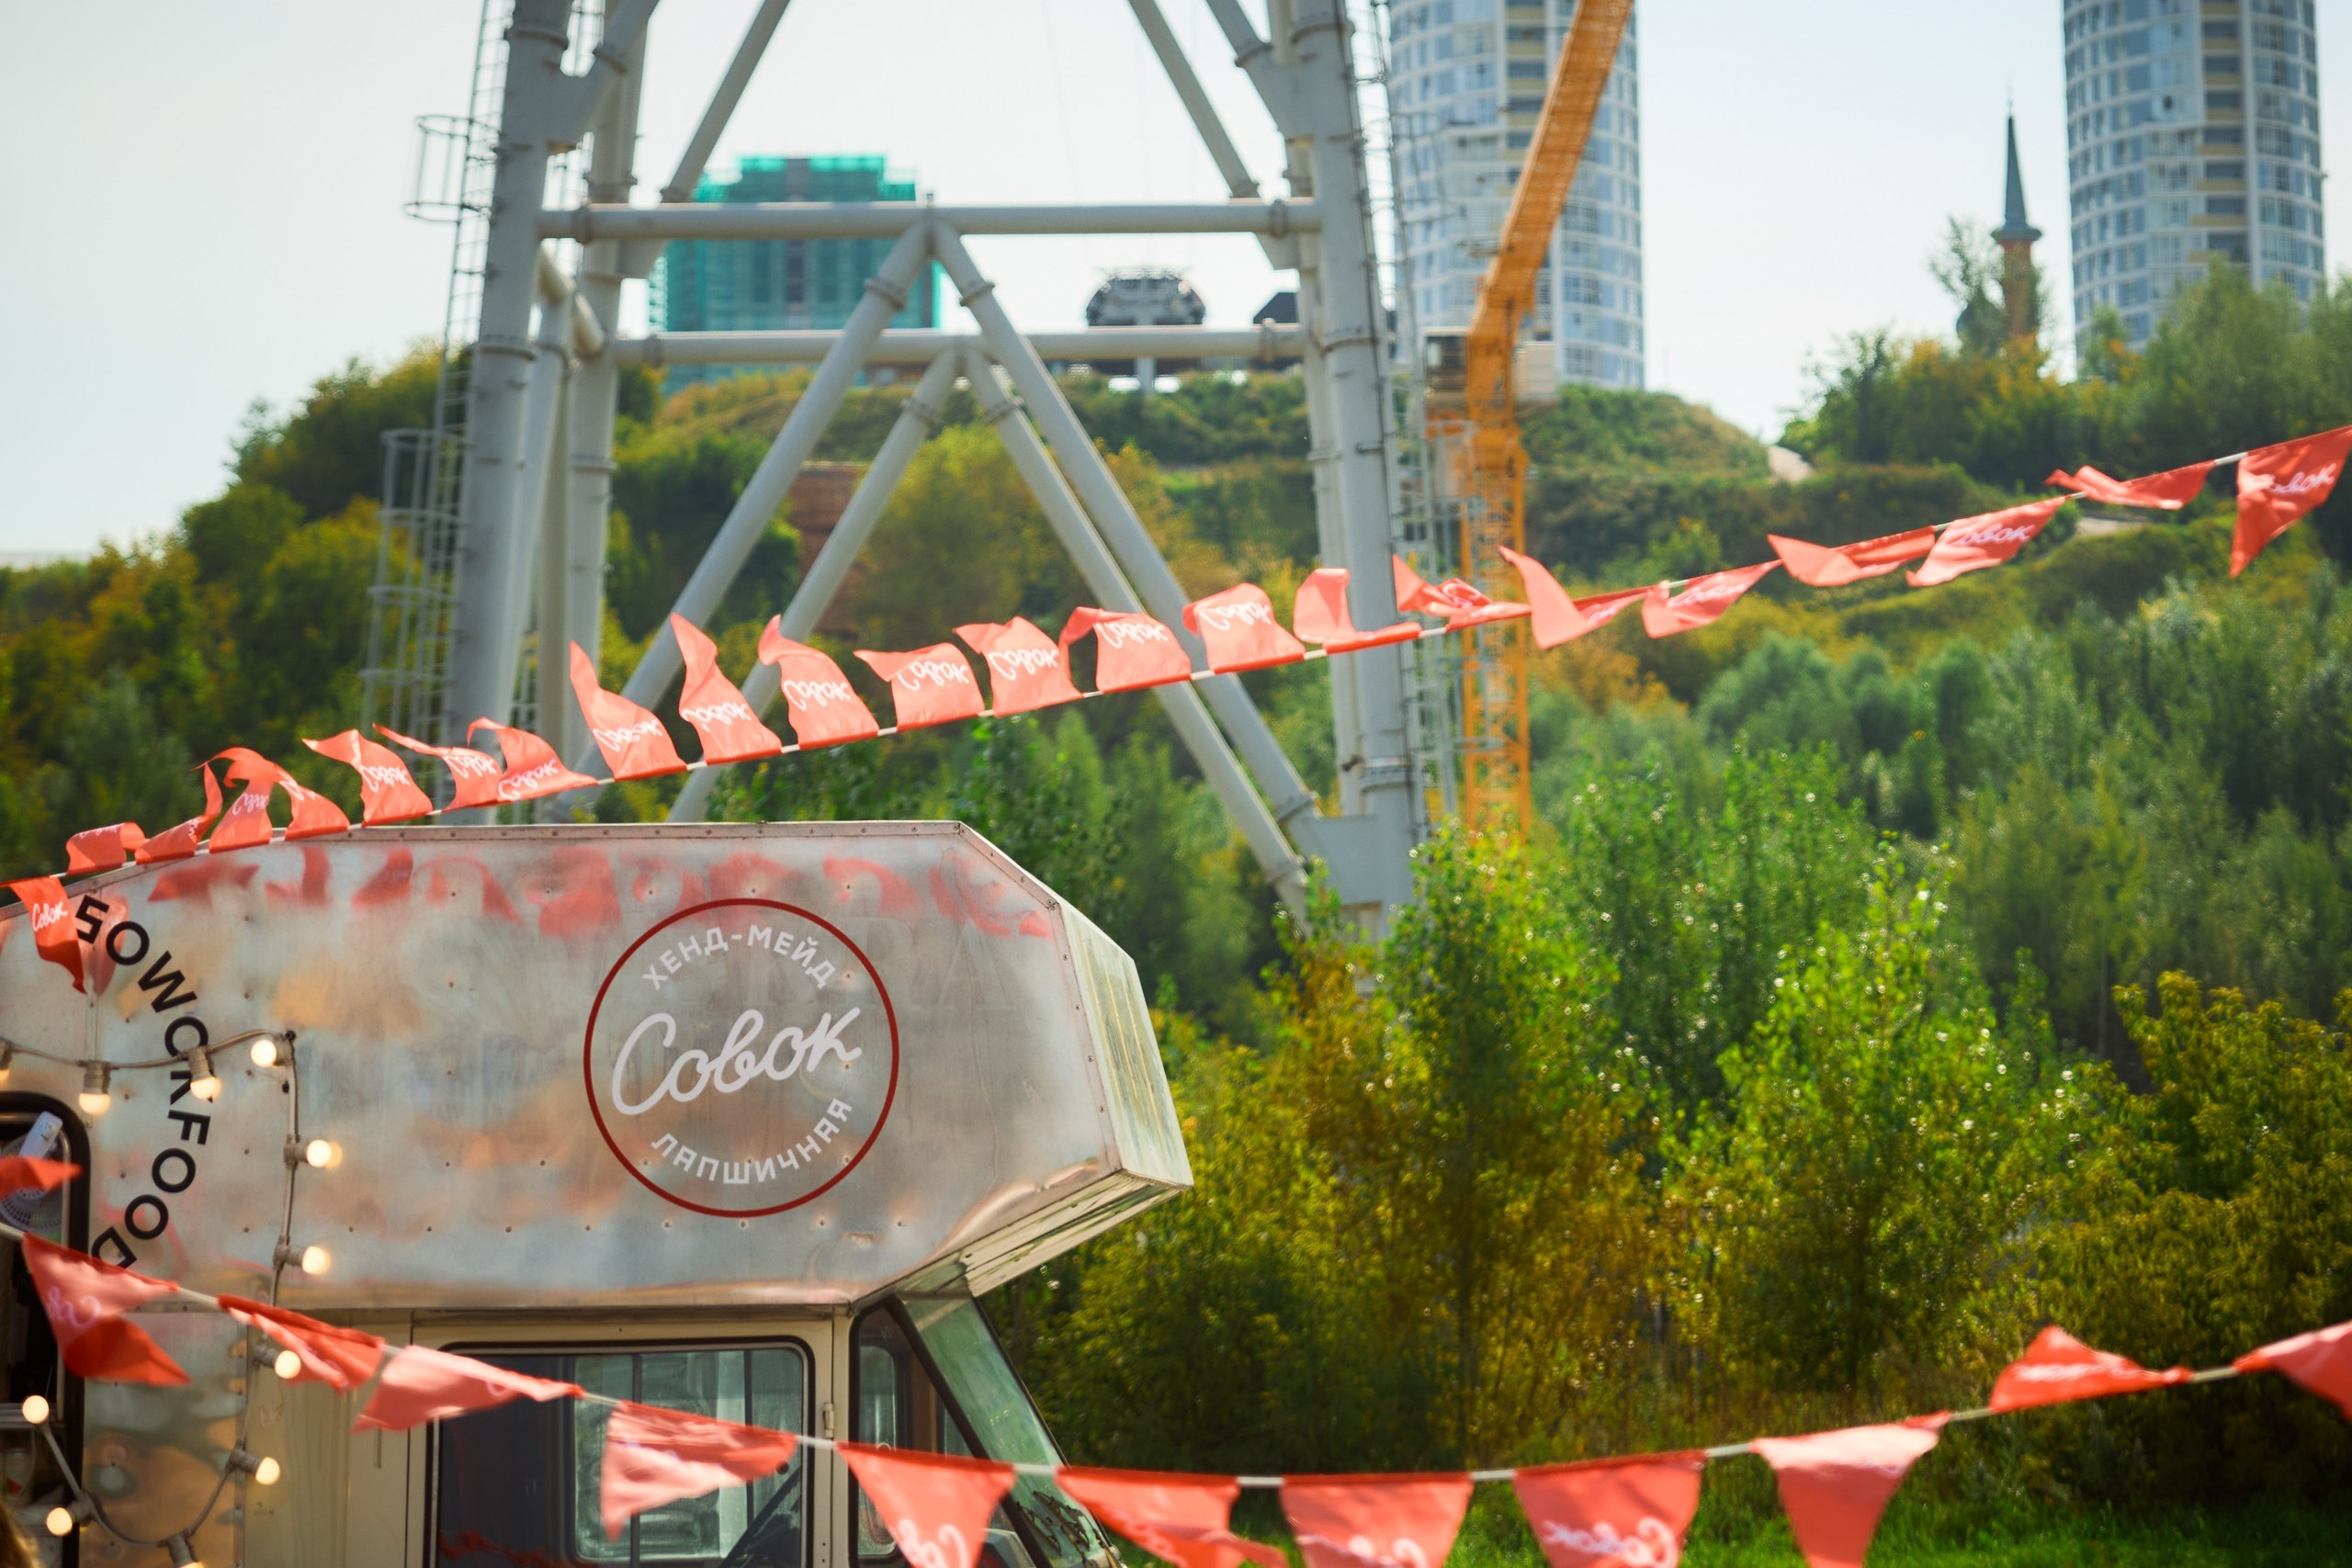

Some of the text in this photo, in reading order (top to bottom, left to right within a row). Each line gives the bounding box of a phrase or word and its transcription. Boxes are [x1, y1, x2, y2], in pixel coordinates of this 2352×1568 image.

[32, 901, 68, 931] Совок
[642, 925, 836, 990] ХЕНД-МЕЙД
[612, 1007, 863, 1115] Совок
[650, 1099, 853, 1184] ЛАПШИЧНАЯ
